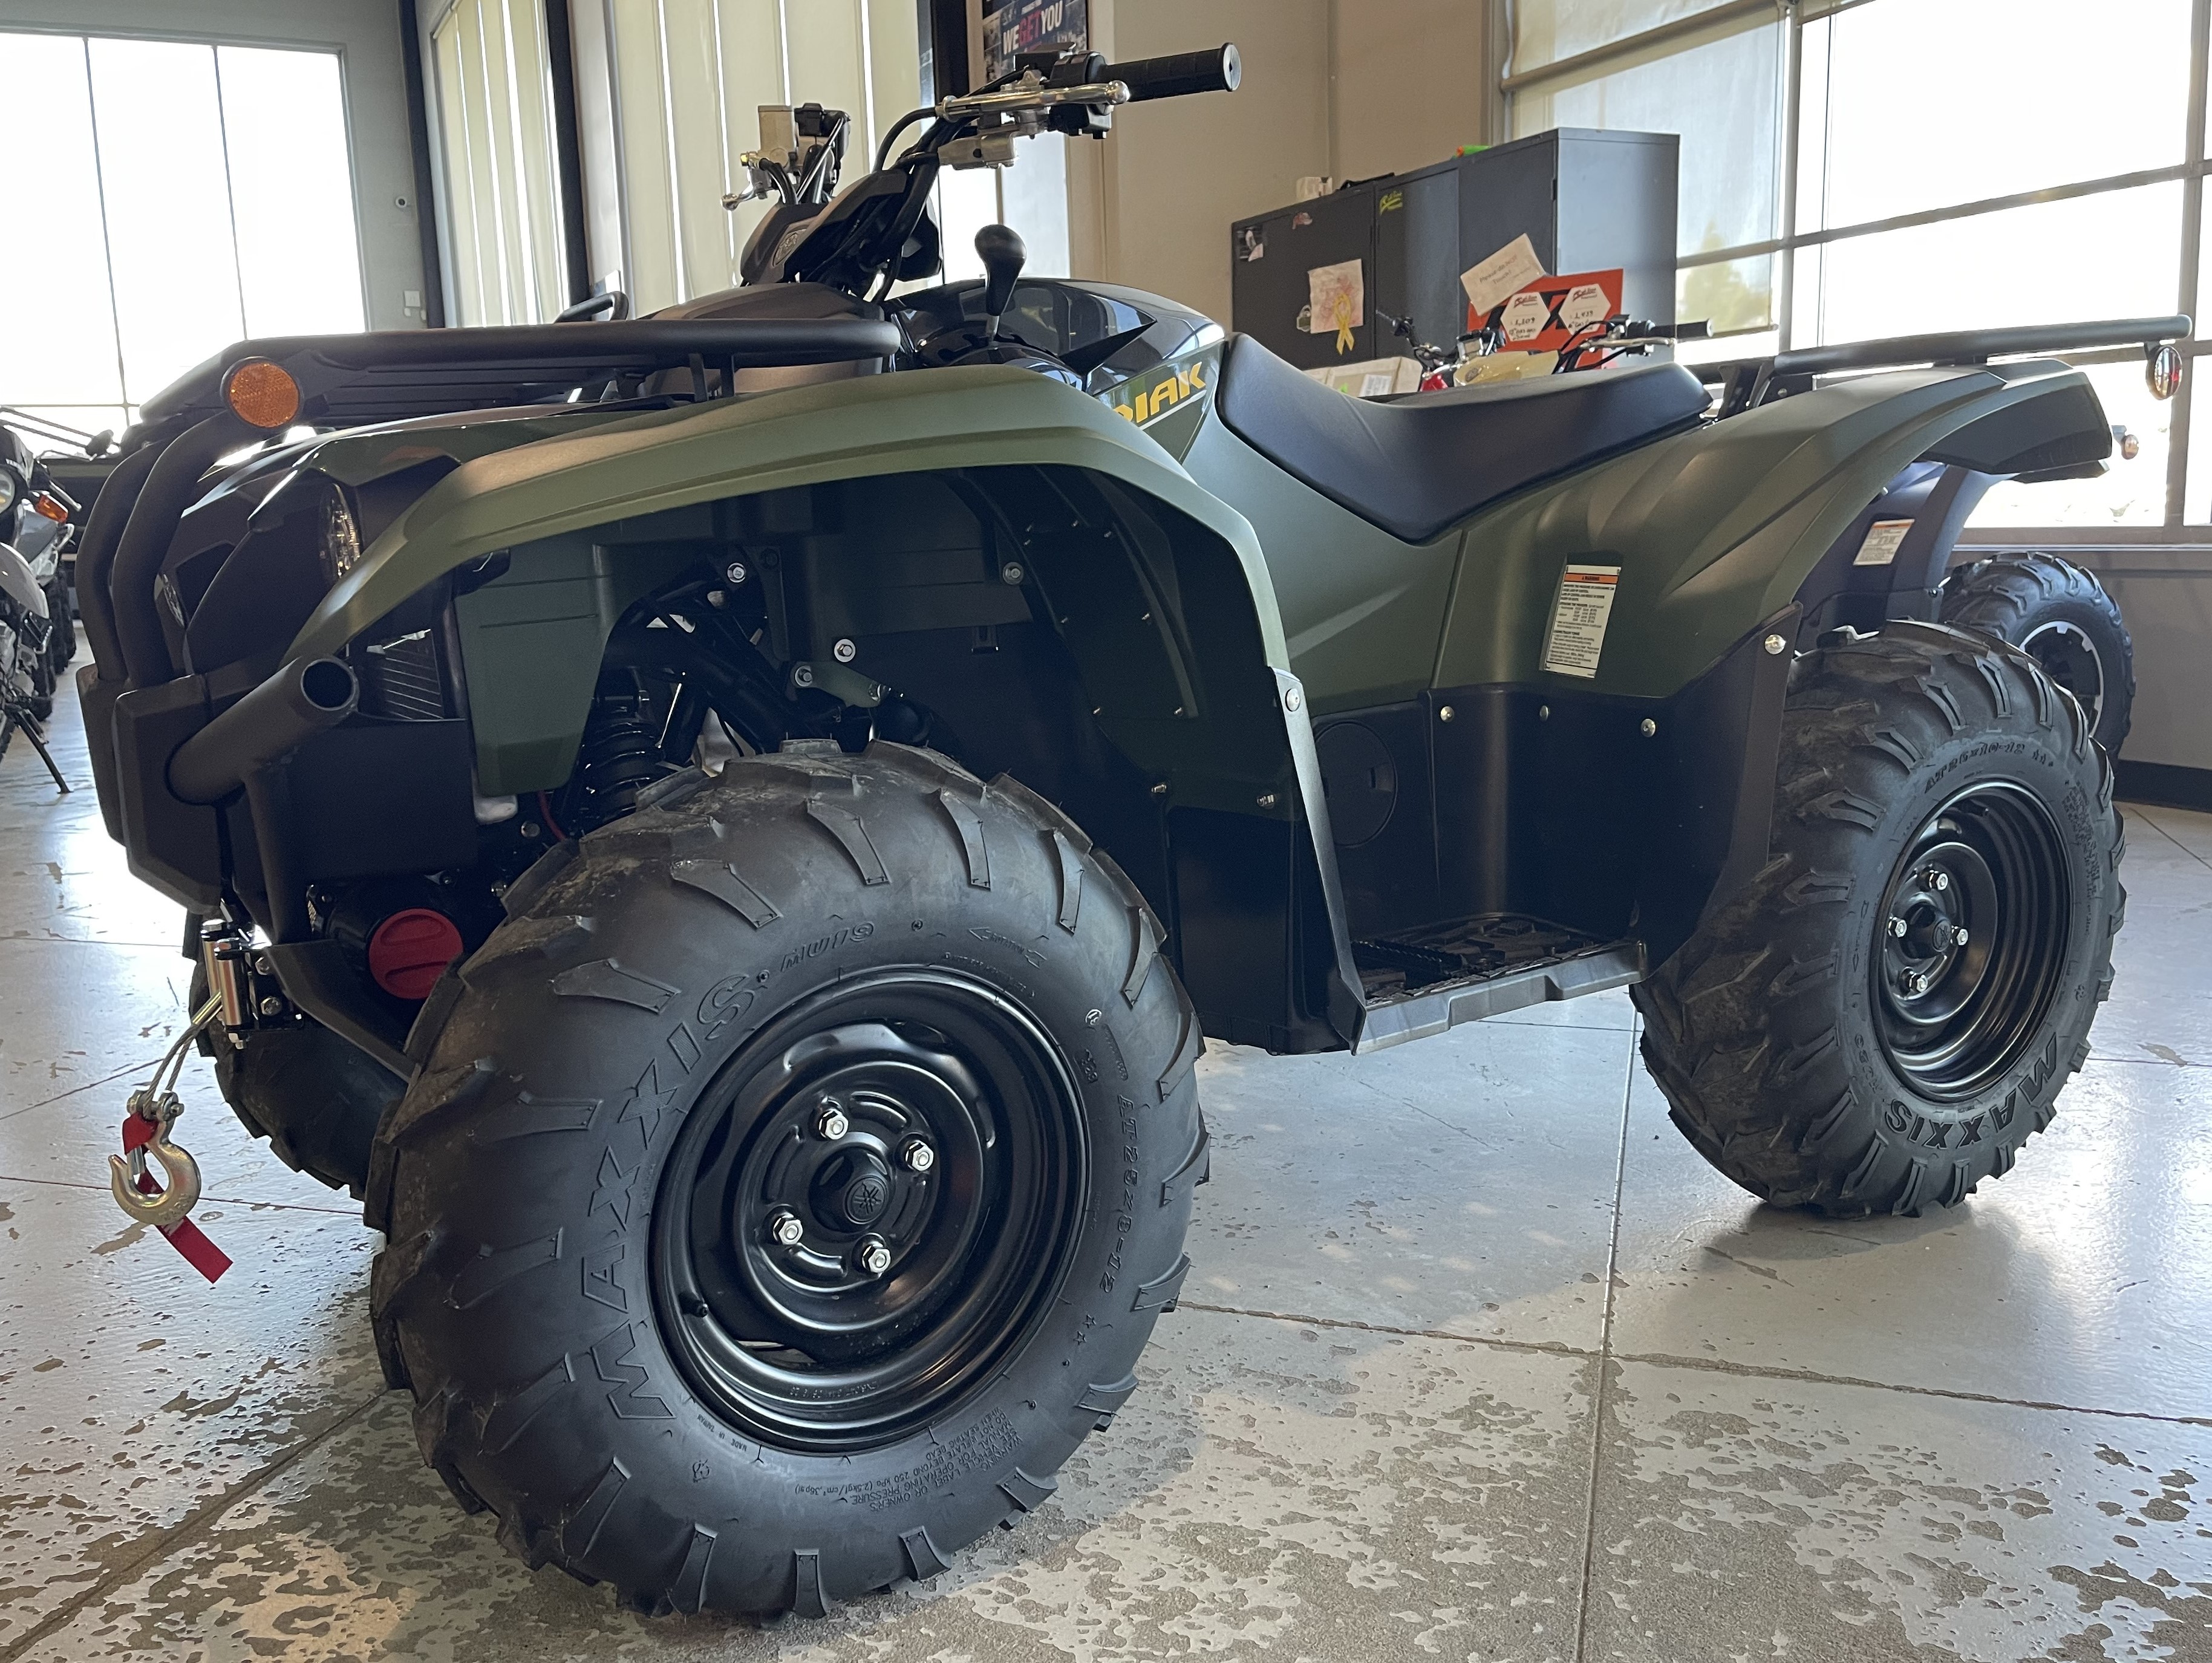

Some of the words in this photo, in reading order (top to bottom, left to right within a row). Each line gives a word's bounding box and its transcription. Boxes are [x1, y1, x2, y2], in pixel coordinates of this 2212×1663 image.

[1003, 24, 1020, 55] WE
[1019, 10, 1042, 47] GET
[1040, 0, 1063, 35] YOU
[1885, 1031, 2057, 1150] MAXXIS
[581, 972, 757, 1420] MAXXIS
[995, 1411, 1006, 1424] DO
[977, 1419, 1013, 1450] MANUAL
[979, 1422, 994, 1439] NOT
[731, 1438, 748, 1452] MADE
[946, 1435, 977, 1460] INFLATE
[957, 1447, 976, 1465] FOR
[913, 1456, 944, 1476] BEYOND
[963, 1443, 999, 1471] VEHICLE
[894, 1471, 910, 1483] 250
[904, 1461, 954, 1491] OPERATING
[914, 1485, 928, 1497] OR
